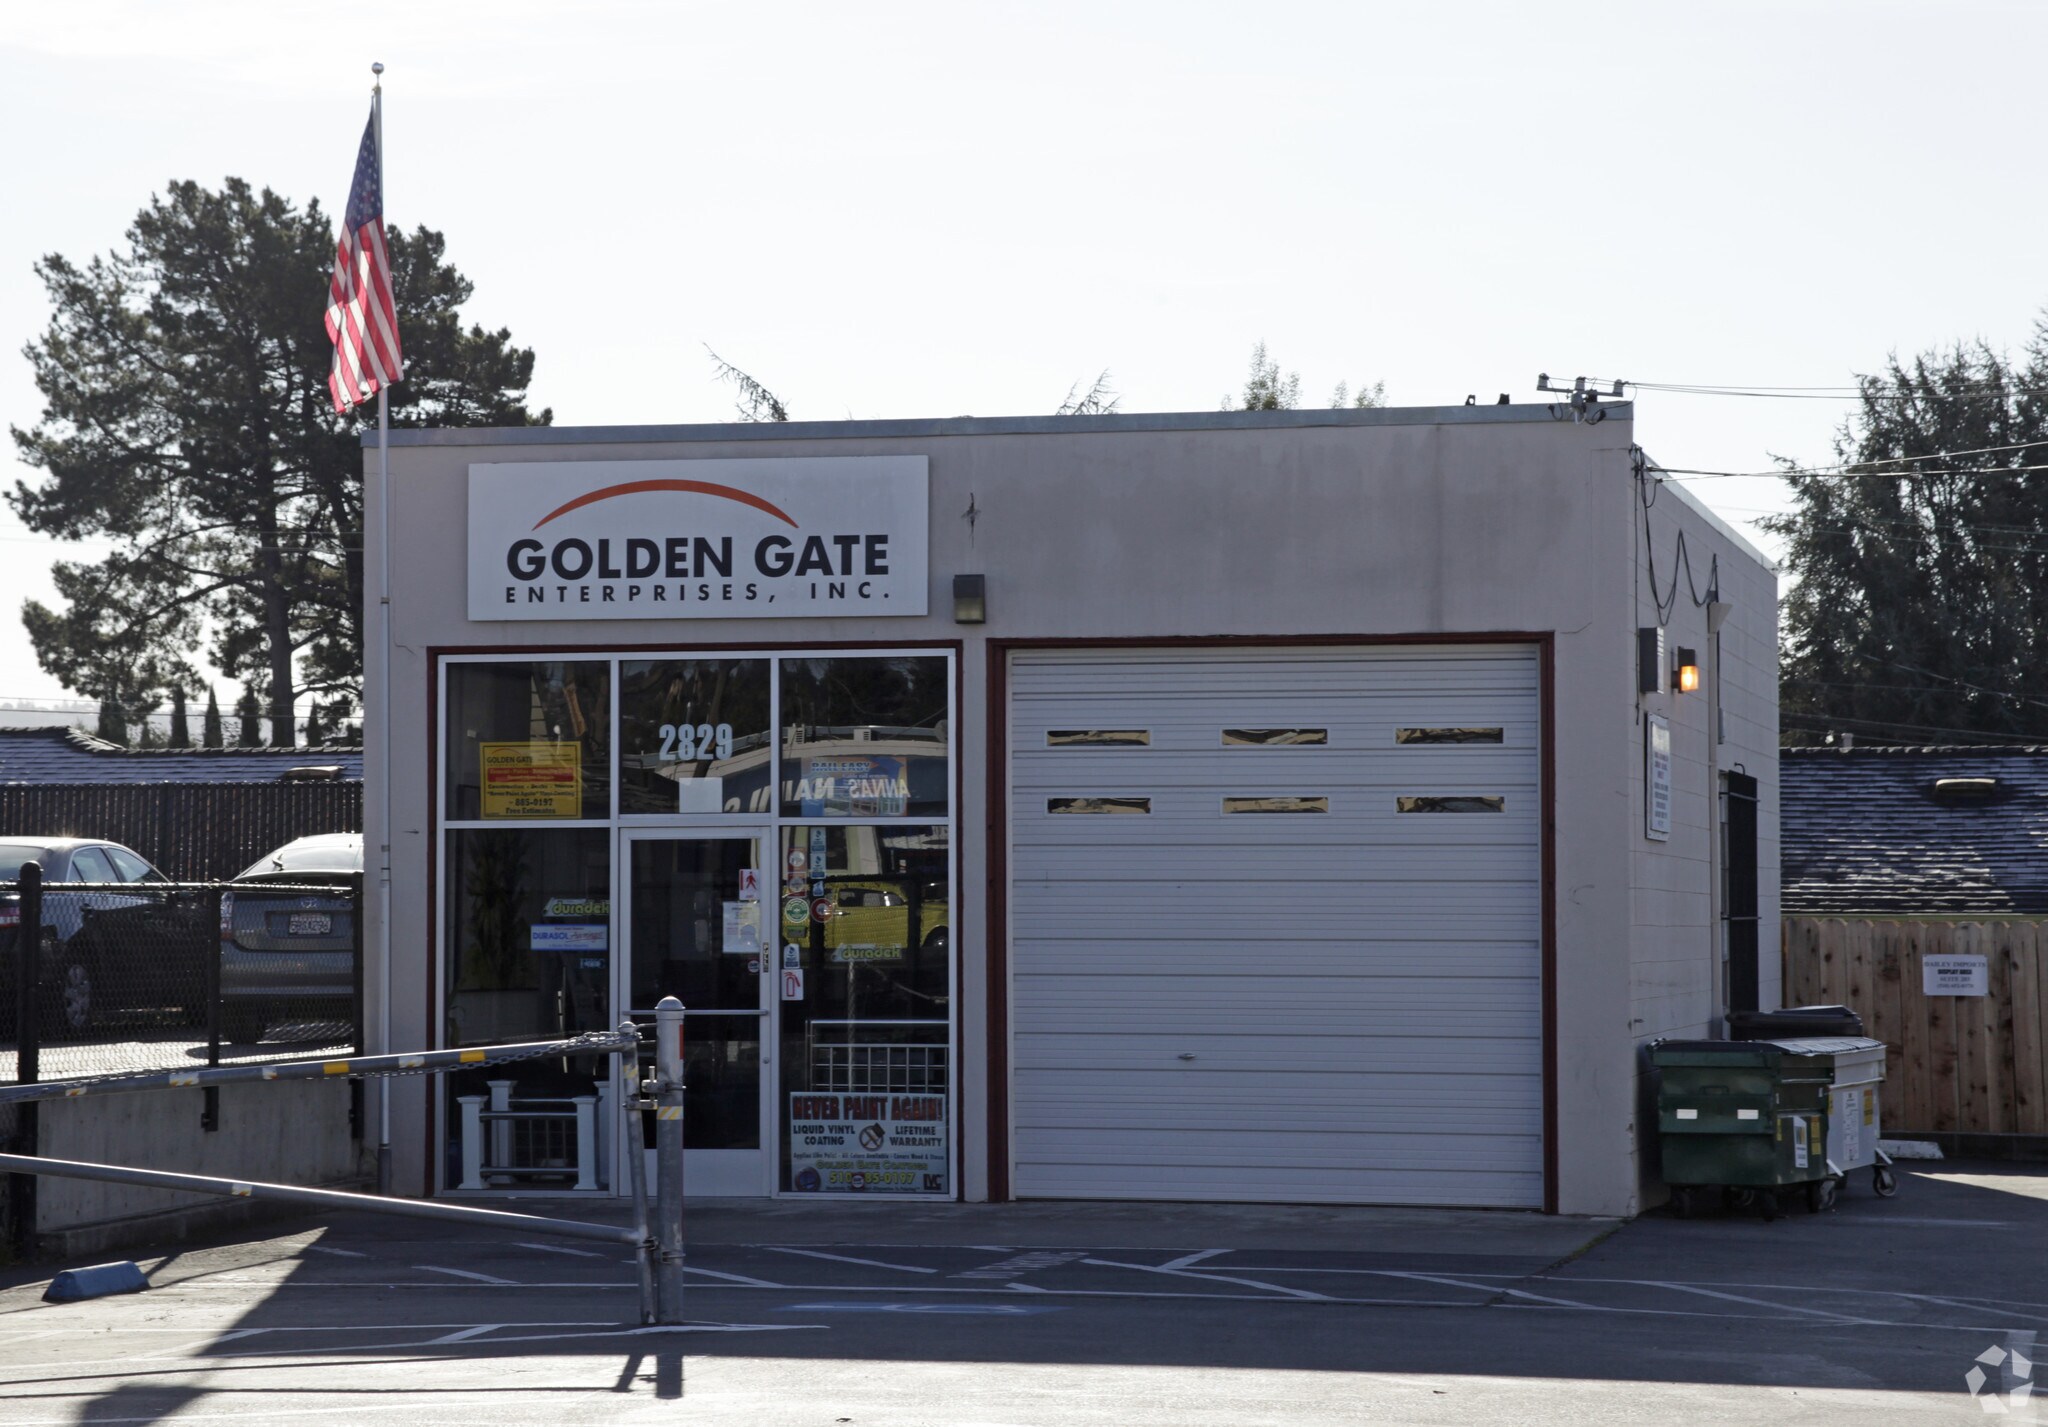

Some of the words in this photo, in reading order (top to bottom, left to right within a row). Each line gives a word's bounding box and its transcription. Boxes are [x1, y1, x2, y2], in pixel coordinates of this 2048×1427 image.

[507, 536, 733, 581] GOLDEN
[754, 534, 889, 578] GATE
[506, 582, 776, 604] ENTERPRISES,
[810, 581, 890, 599] INC.
[658, 723, 733, 761] 2829
[486, 756, 514, 764] GOLDEN
[515, 798, 553, 807] 885-0197
[793, 1096, 840, 1120] NEVER
[843, 1096, 888, 1121] PAINT
[891, 1096, 943, 1121] AGAIN!
[793, 1125, 825, 1135] LIQUID
[827, 1125, 855, 1135] VINYL
[895, 1126, 936, 1136] LIFETIME
[804, 1136, 845, 1146] COATING
[889, 1137, 942, 1147] WARRANTY
